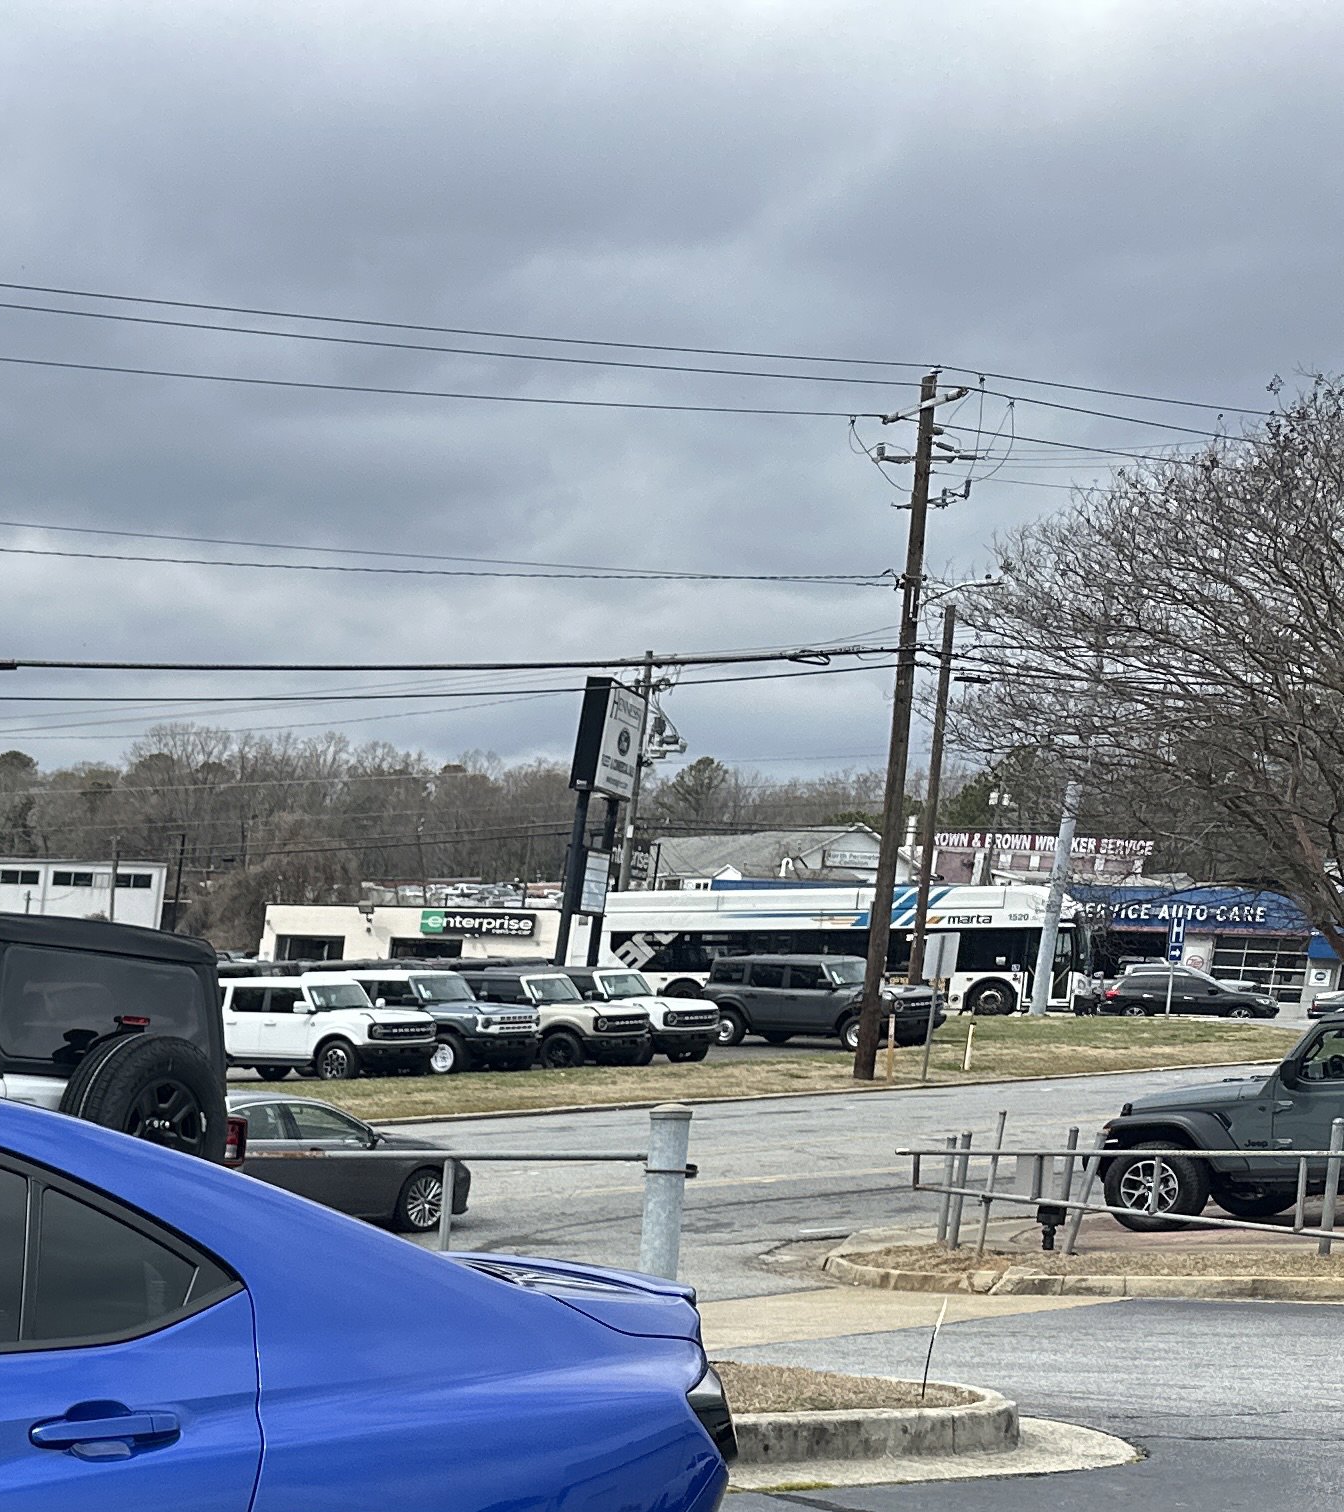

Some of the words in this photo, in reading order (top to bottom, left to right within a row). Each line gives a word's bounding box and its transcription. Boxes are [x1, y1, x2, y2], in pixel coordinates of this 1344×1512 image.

[947, 914, 993, 925] marta
[1008, 913, 1029, 922] 1520
[1215, 905, 1266, 923] CARE
[427, 914, 533, 932] enterprise
[1171, 917, 1185, 944] H
[1244, 1139, 1269, 1149] Jeep
